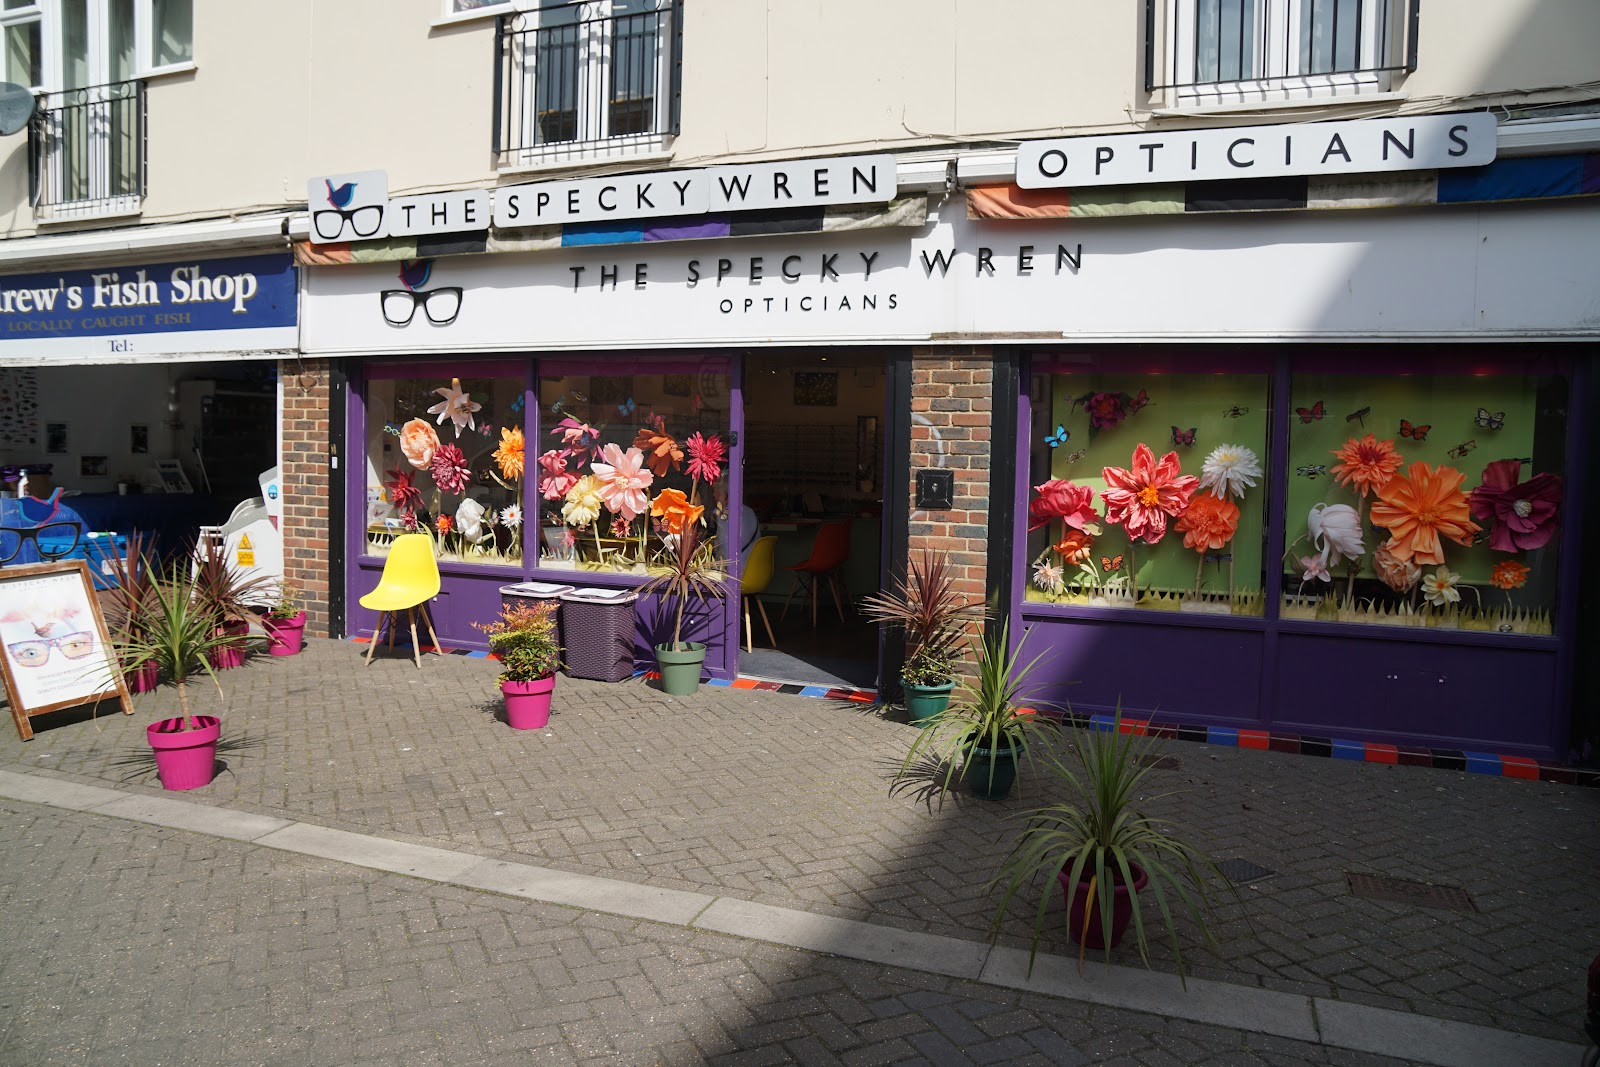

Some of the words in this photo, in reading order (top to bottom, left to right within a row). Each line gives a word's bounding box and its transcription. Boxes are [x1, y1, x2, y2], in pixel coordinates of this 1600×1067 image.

[1038, 124, 1469, 178] OPTICIANS
[402, 199, 476, 228] THE
[508, 179, 691, 219] SPECKY
[718, 165, 877, 202] WREN
[569, 263, 647, 288] THE
[687, 251, 879, 283] SPECKY
[922, 244, 1082, 275] WREN
[0, 278, 83, 313] rew's
[91, 270, 160, 308] Fish
[171, 265, 258, 313] Shop
[719, 294, 898, 314] OPTICIANS
[8, 319, 74, 332] LOCALLY
[81, 315, 146, 329] CAUGHT
[154, 312, 191, 325] FISH
[108, 339, 134, 353] Tel:
